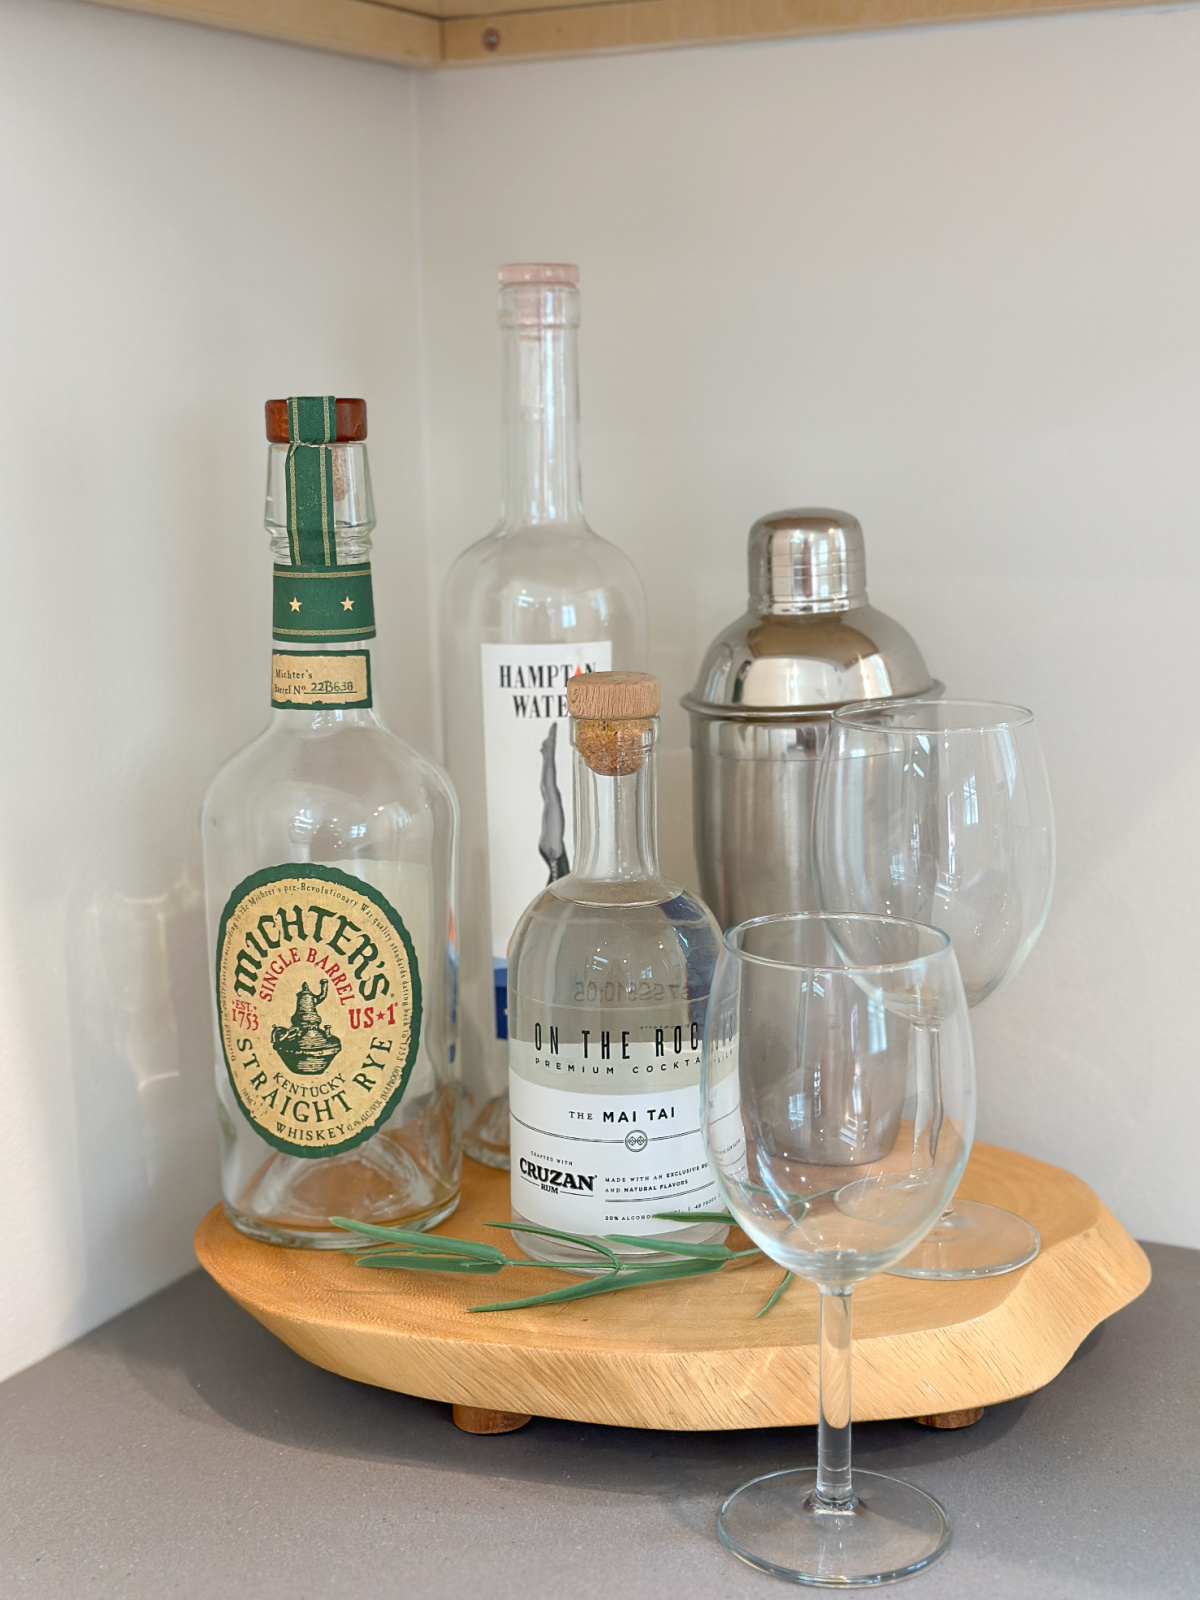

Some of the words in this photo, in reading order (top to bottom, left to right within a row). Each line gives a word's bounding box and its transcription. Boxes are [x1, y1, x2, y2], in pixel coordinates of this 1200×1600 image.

[275, 668, 313, 679] Michter's
[274, 683, 291, 695] Barrel
[310, 680, 354, 693] 22B638
[513, 694, 568, 718] WATE
[248, 887, 282, 907] Michter's
[284, 882, 359, 908] pre-Revolutionary
[361, 903, 373, 918] War
[372, 918, 392, 942] quality
[233, 904, 390, 1001] MICHTER'S
[390, 942, 406, 979] standards
[259, 947, 301, 1002] SINGLE
[306, 947, 355, 1006] BARREL
[402, 981, 410, 1007] dating
[232, 1008, 259, 1031] 1753
[402, 1009, 411, 1026] back
[535, 1022, 559, 1055] ON
[581, 1030, 630, 1060] THE
[535, 1057, 614, 1075] PREMIUM
[237, 1037, 353, 1123] STRAIGHT
[353, 1037, 393, 1093] RYE
[273, 1072, 345, 1098] KENTUCKY
[568, 1110, 593, 1120] THE
[602, 1111, 637, 1123] MAI
[647, 1106, 675, 1121] TAI
[275, 1121, 345, 1141] WHISKEY
[530, 1150, 554, 1162] CRAFTED
[556, 1158, 573, 1167] WITH
[519, 1157, 595, 1192] CRUZAN
[666, 1165, 700, 1179] EXCLUSIVE
[540, 1183, 559, 1195] RUM
[624, 1185, 657, 1193] NATURAL
[659, 1179, 689, 1190] FLAVORS
